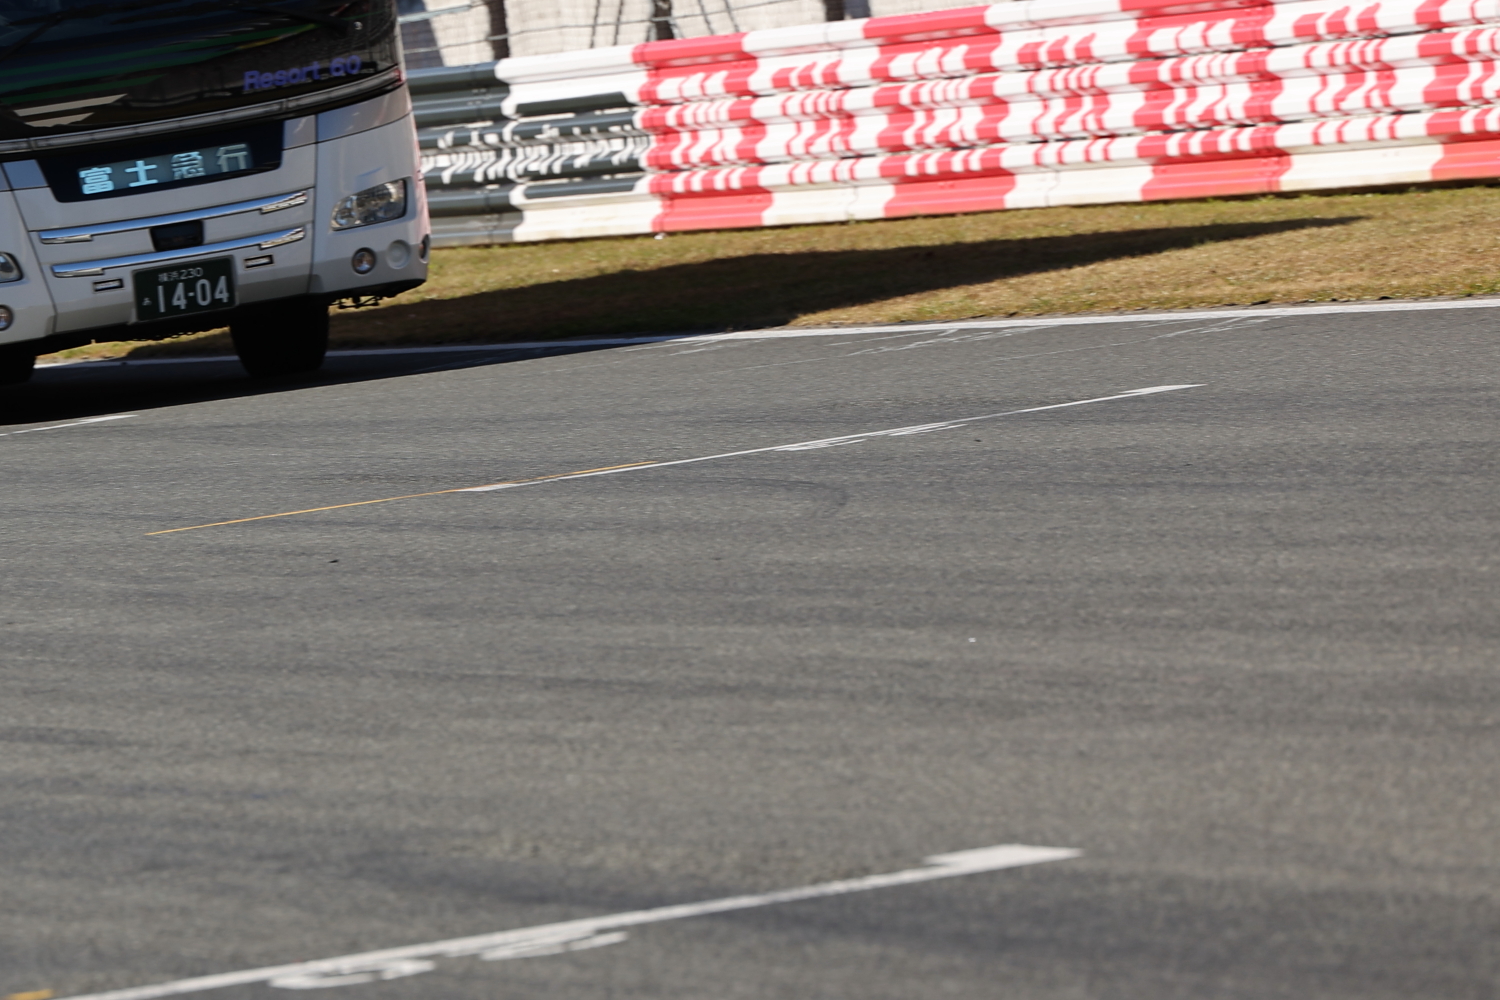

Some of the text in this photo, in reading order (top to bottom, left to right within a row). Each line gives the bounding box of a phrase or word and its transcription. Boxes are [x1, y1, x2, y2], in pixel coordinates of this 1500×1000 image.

[243, 55, 362, 91] Resort 60
[79, 143, 249, 195] 富士急行
[157, 275, 229, 312] 14-04
